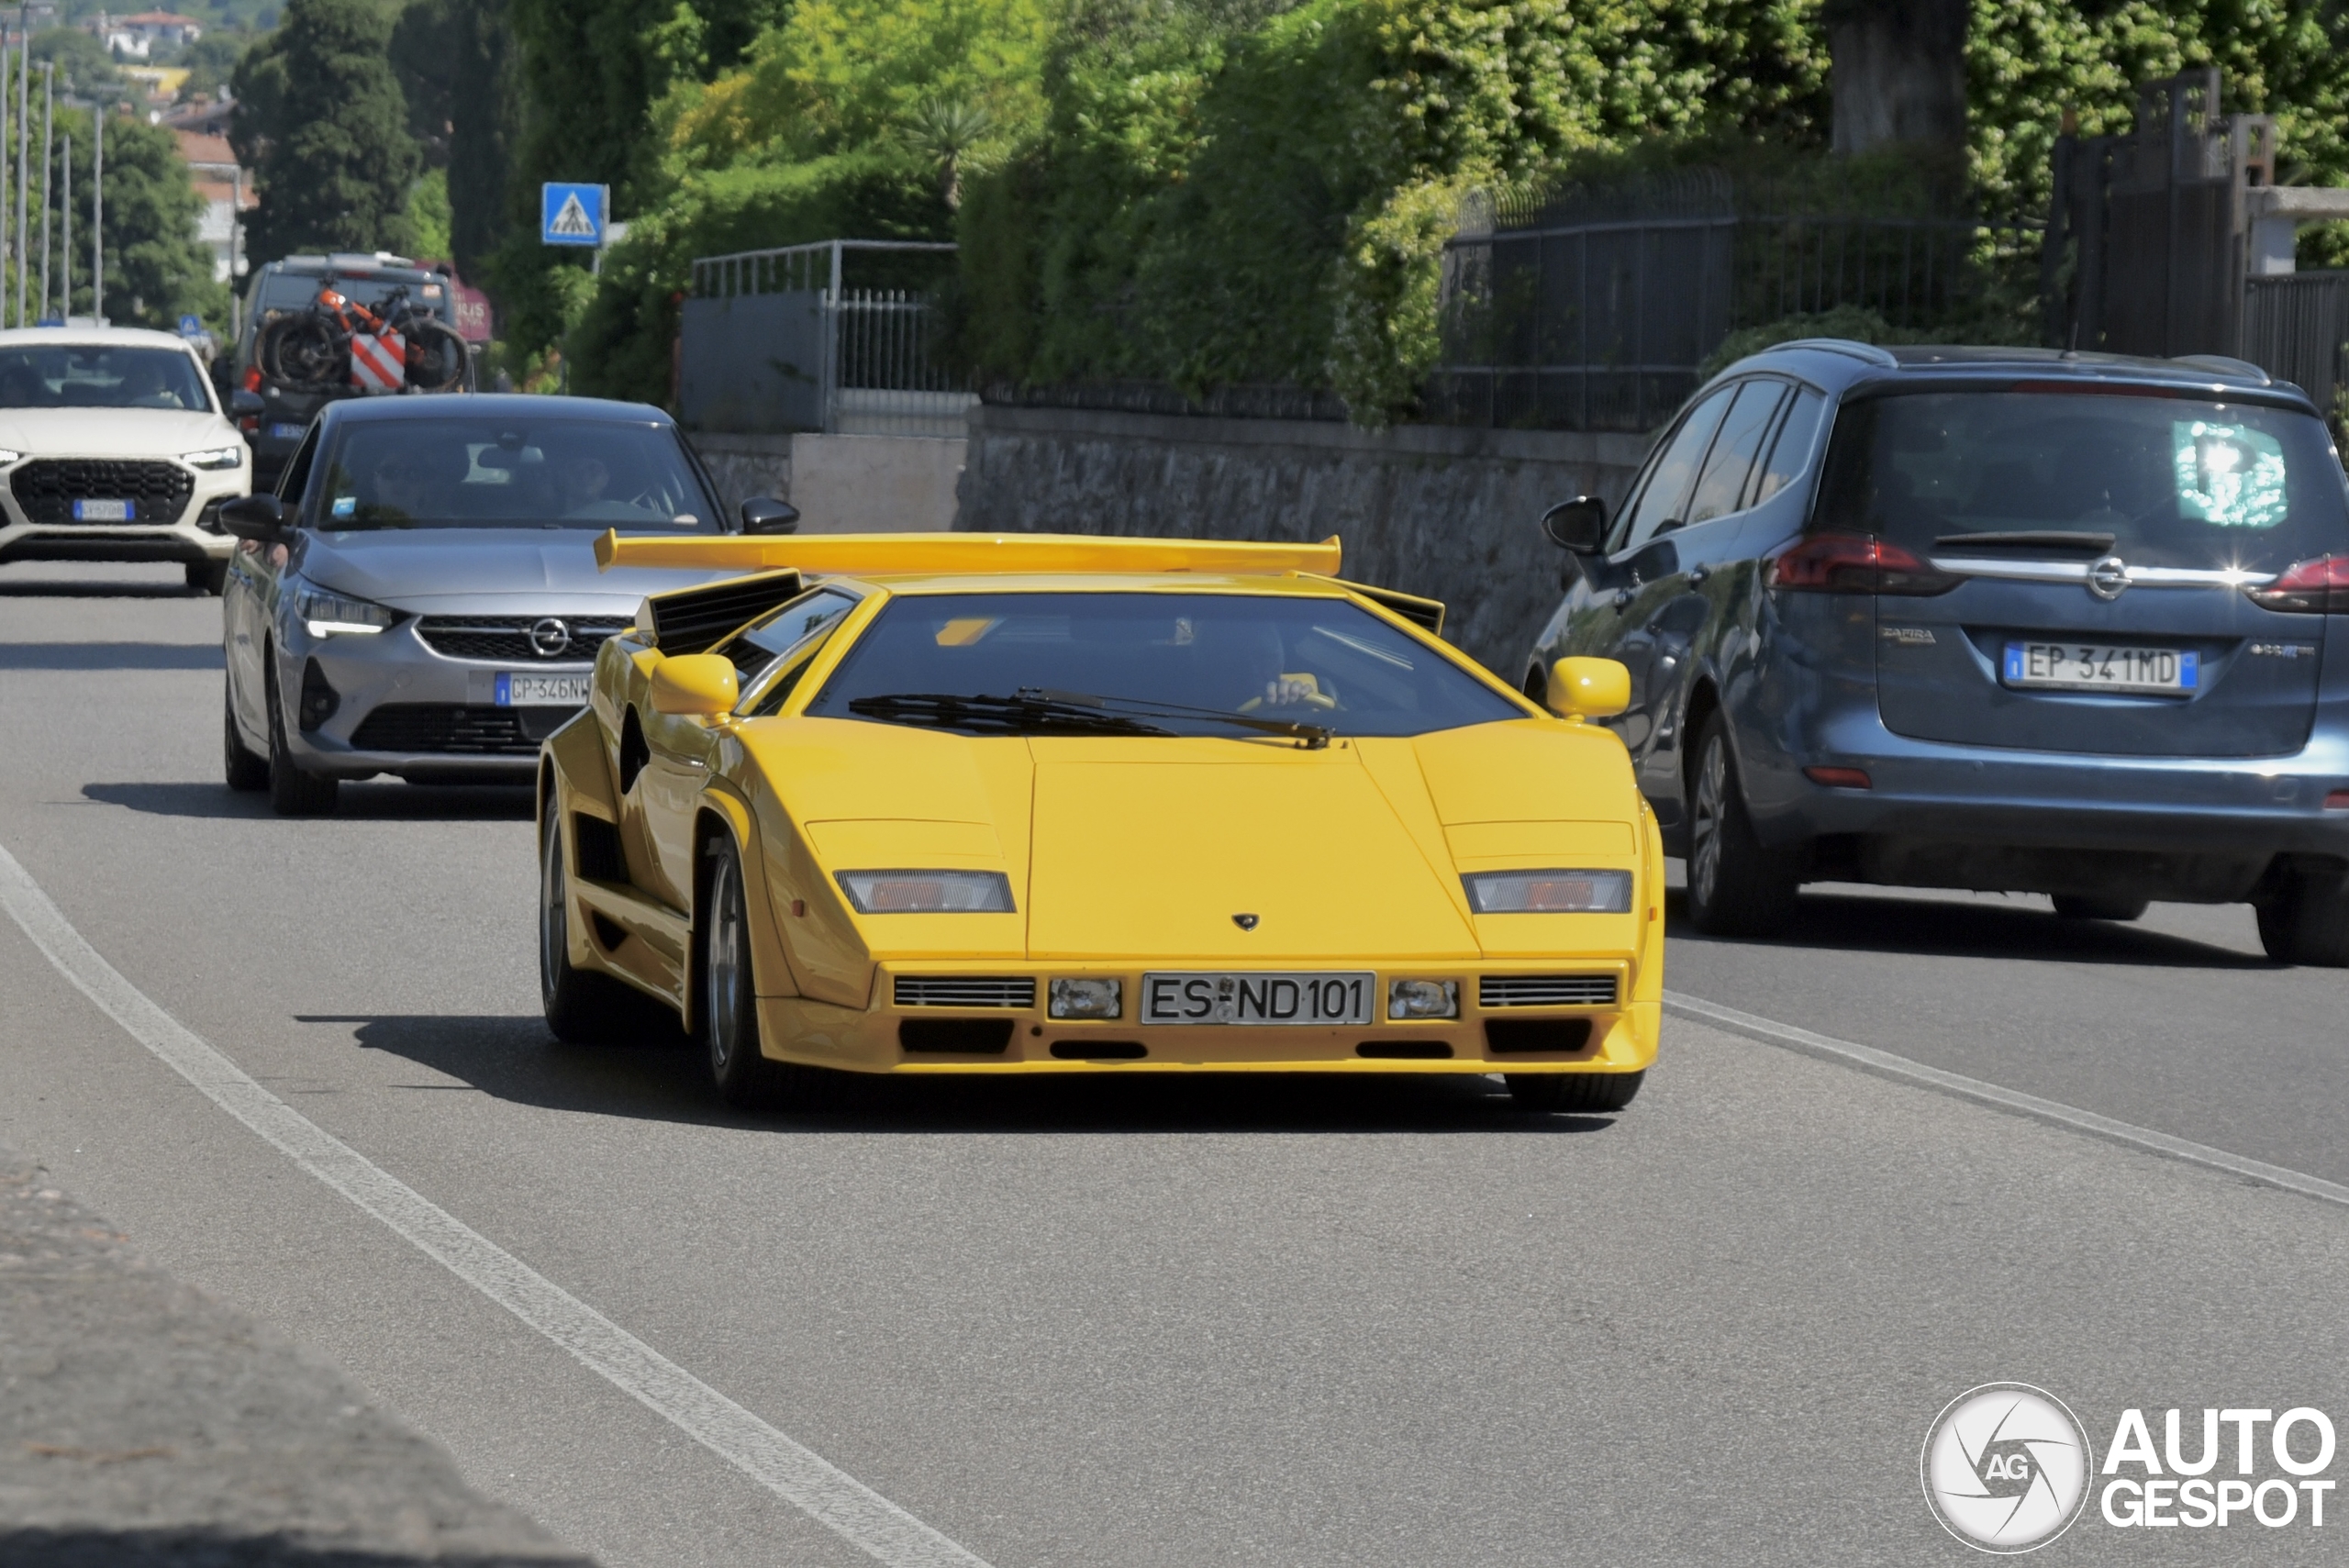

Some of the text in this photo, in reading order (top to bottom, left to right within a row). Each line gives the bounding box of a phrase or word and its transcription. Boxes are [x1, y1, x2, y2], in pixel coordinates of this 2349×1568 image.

[2029, 645, 2064, 677] EP
[2078, 648, 2176, 683] 341MD
[1308, 978, 1364, 1018] 101
